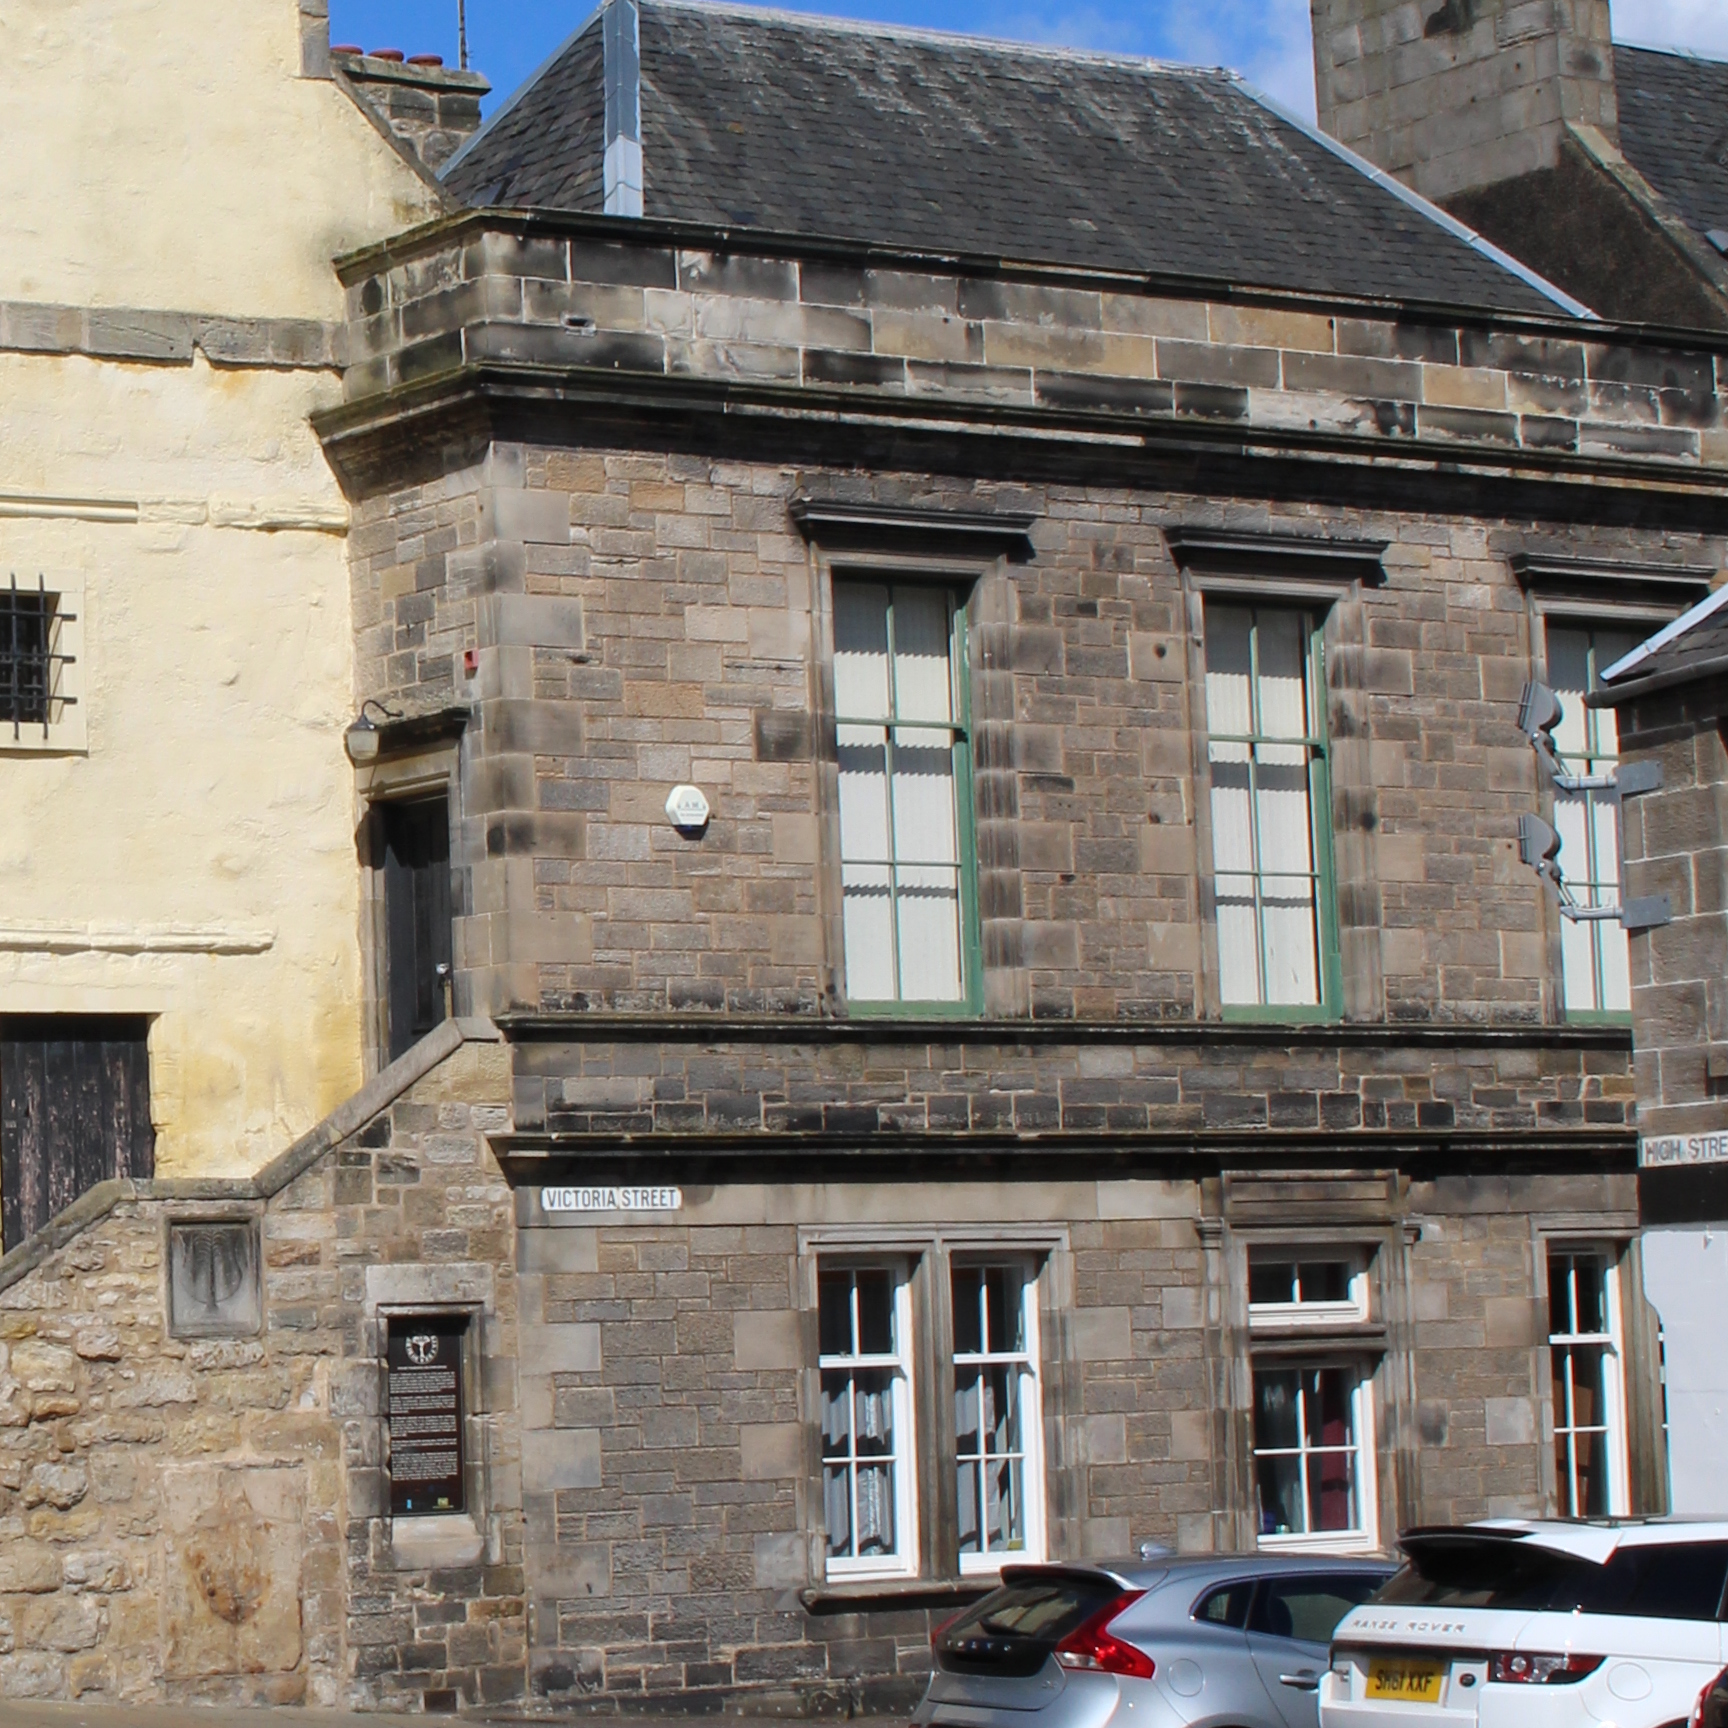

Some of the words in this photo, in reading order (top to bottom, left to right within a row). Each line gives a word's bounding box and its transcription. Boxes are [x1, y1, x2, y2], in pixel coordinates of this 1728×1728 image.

[546, 1189, 617, 1208] VICTORIA
[621, 1189, 677, 1207] STREET
[1406, 1621, 1466, 1633] ROVER
[1406, 1671, 1435, 1693] XXF
